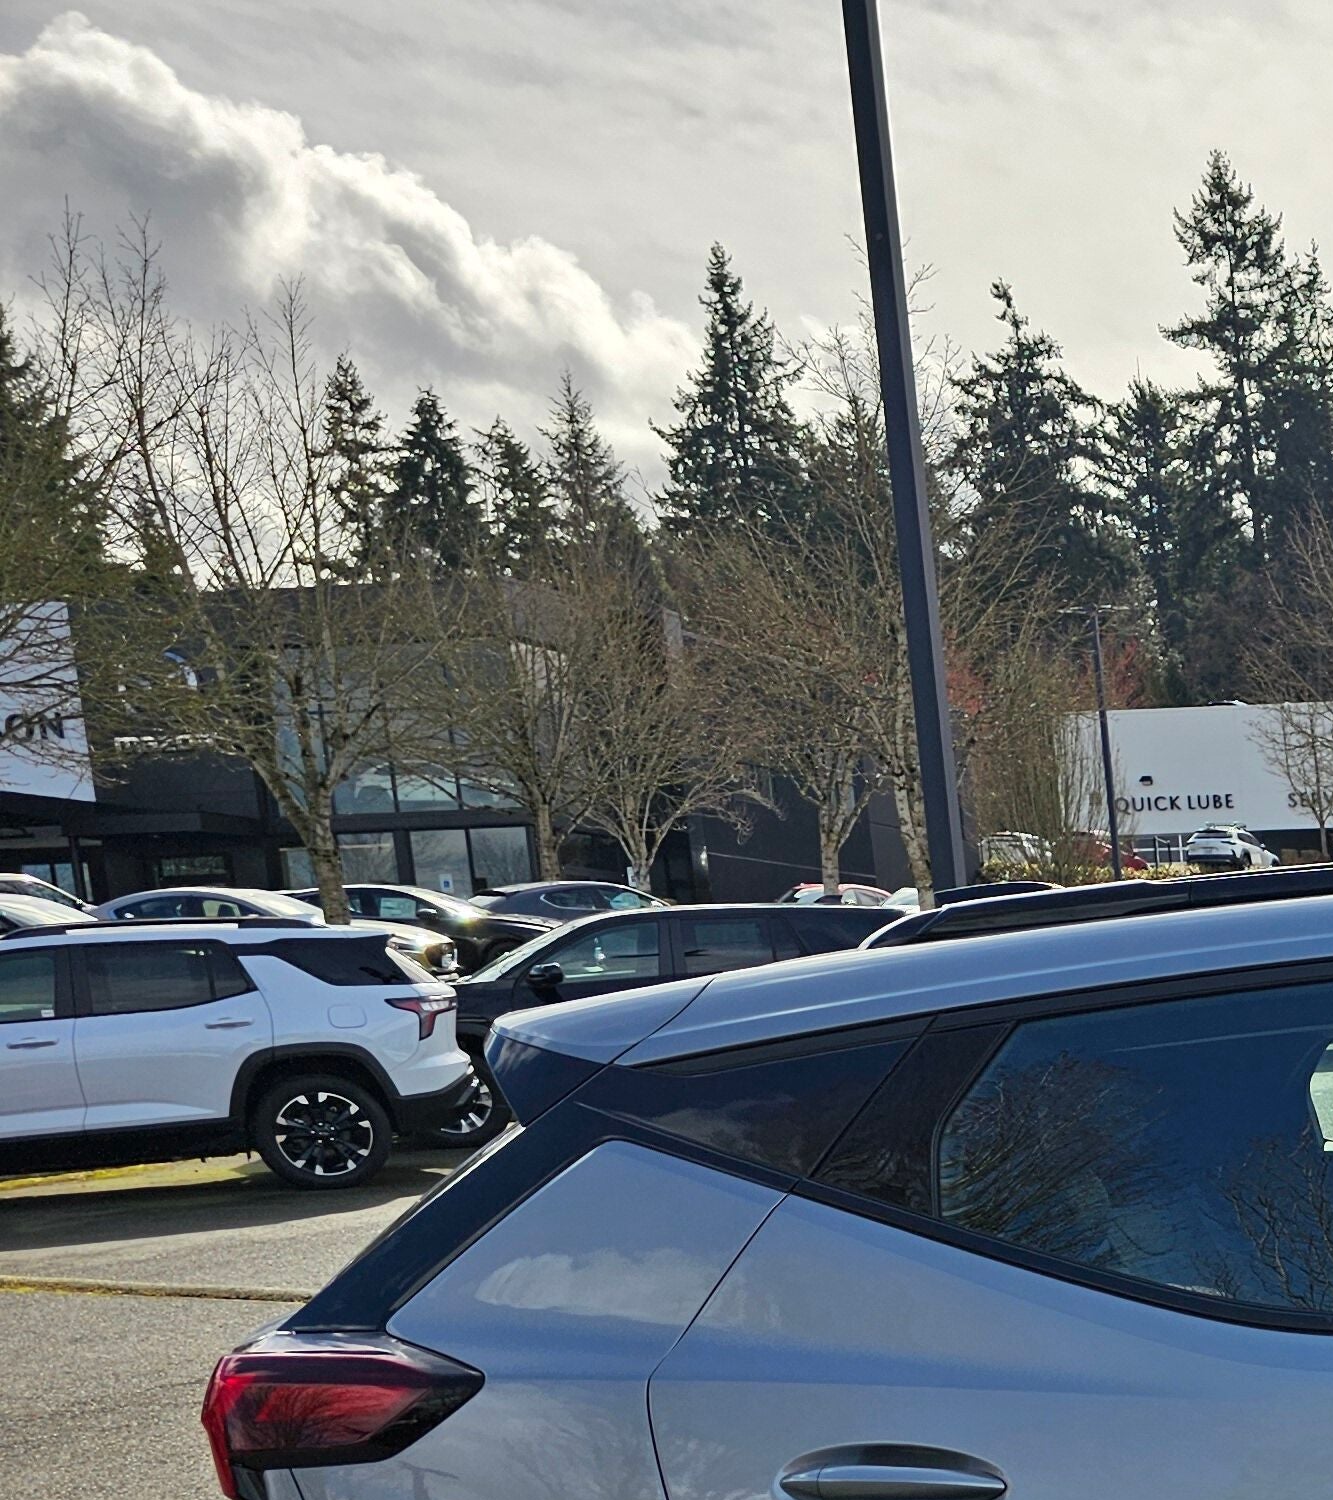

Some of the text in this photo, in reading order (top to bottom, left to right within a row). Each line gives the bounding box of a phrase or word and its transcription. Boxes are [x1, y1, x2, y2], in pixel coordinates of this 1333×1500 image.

[0, 711, 65, 740] ON
[1115, 793, 1235, 815] QUICK LUBE
